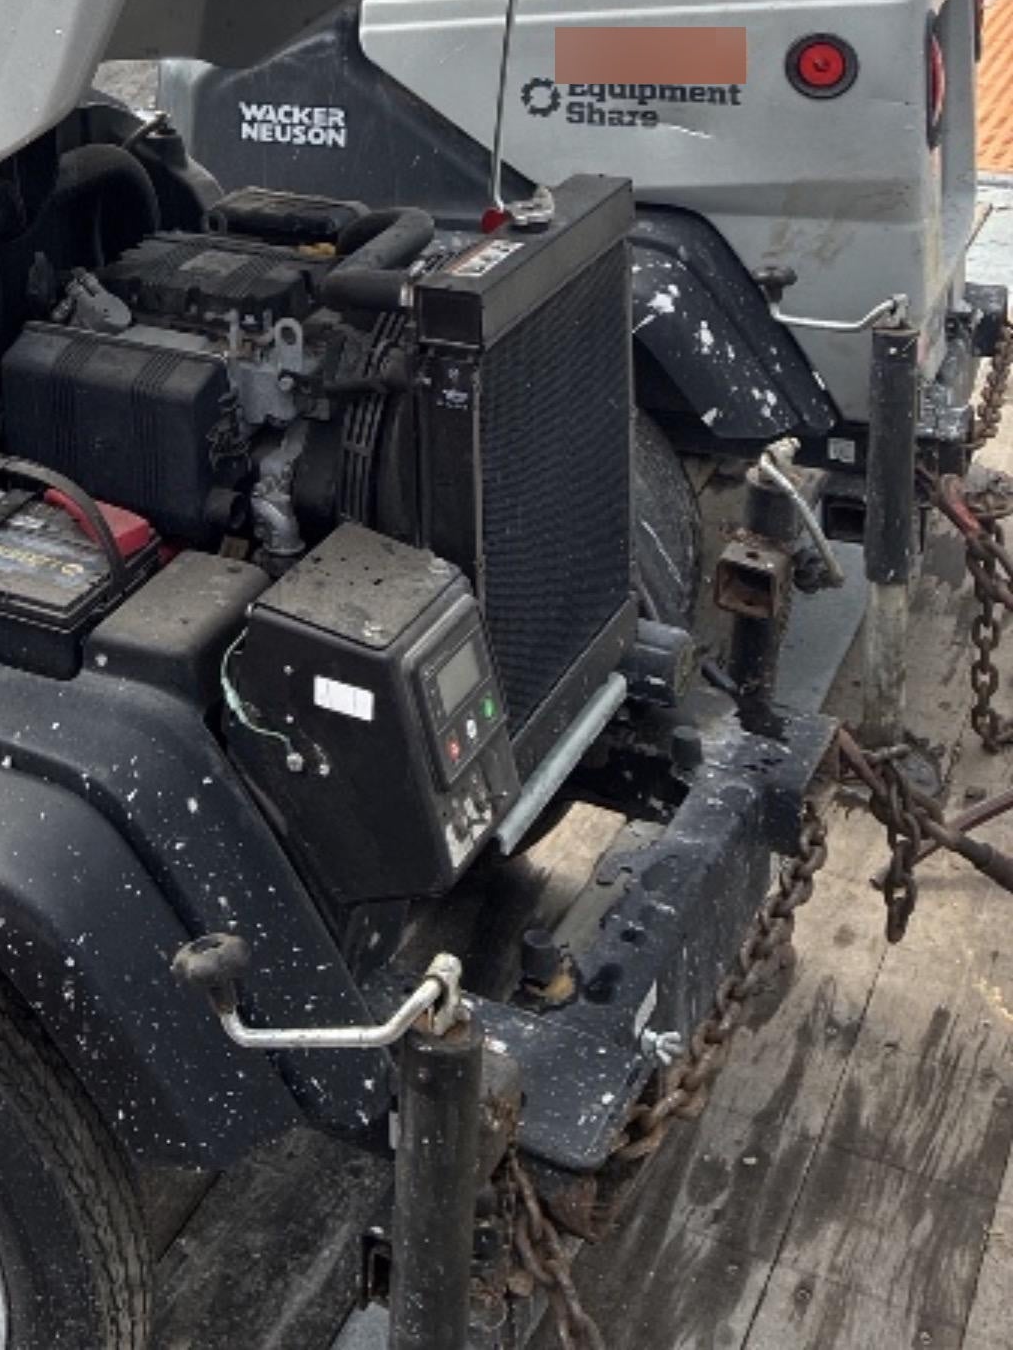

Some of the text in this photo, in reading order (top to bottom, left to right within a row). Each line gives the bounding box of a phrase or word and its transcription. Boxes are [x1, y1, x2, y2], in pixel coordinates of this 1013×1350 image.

[238, 101, 346, 127] WACKER
[565, 101, 660, 128] Share
[240, 121, 348, 148] NEUSON
